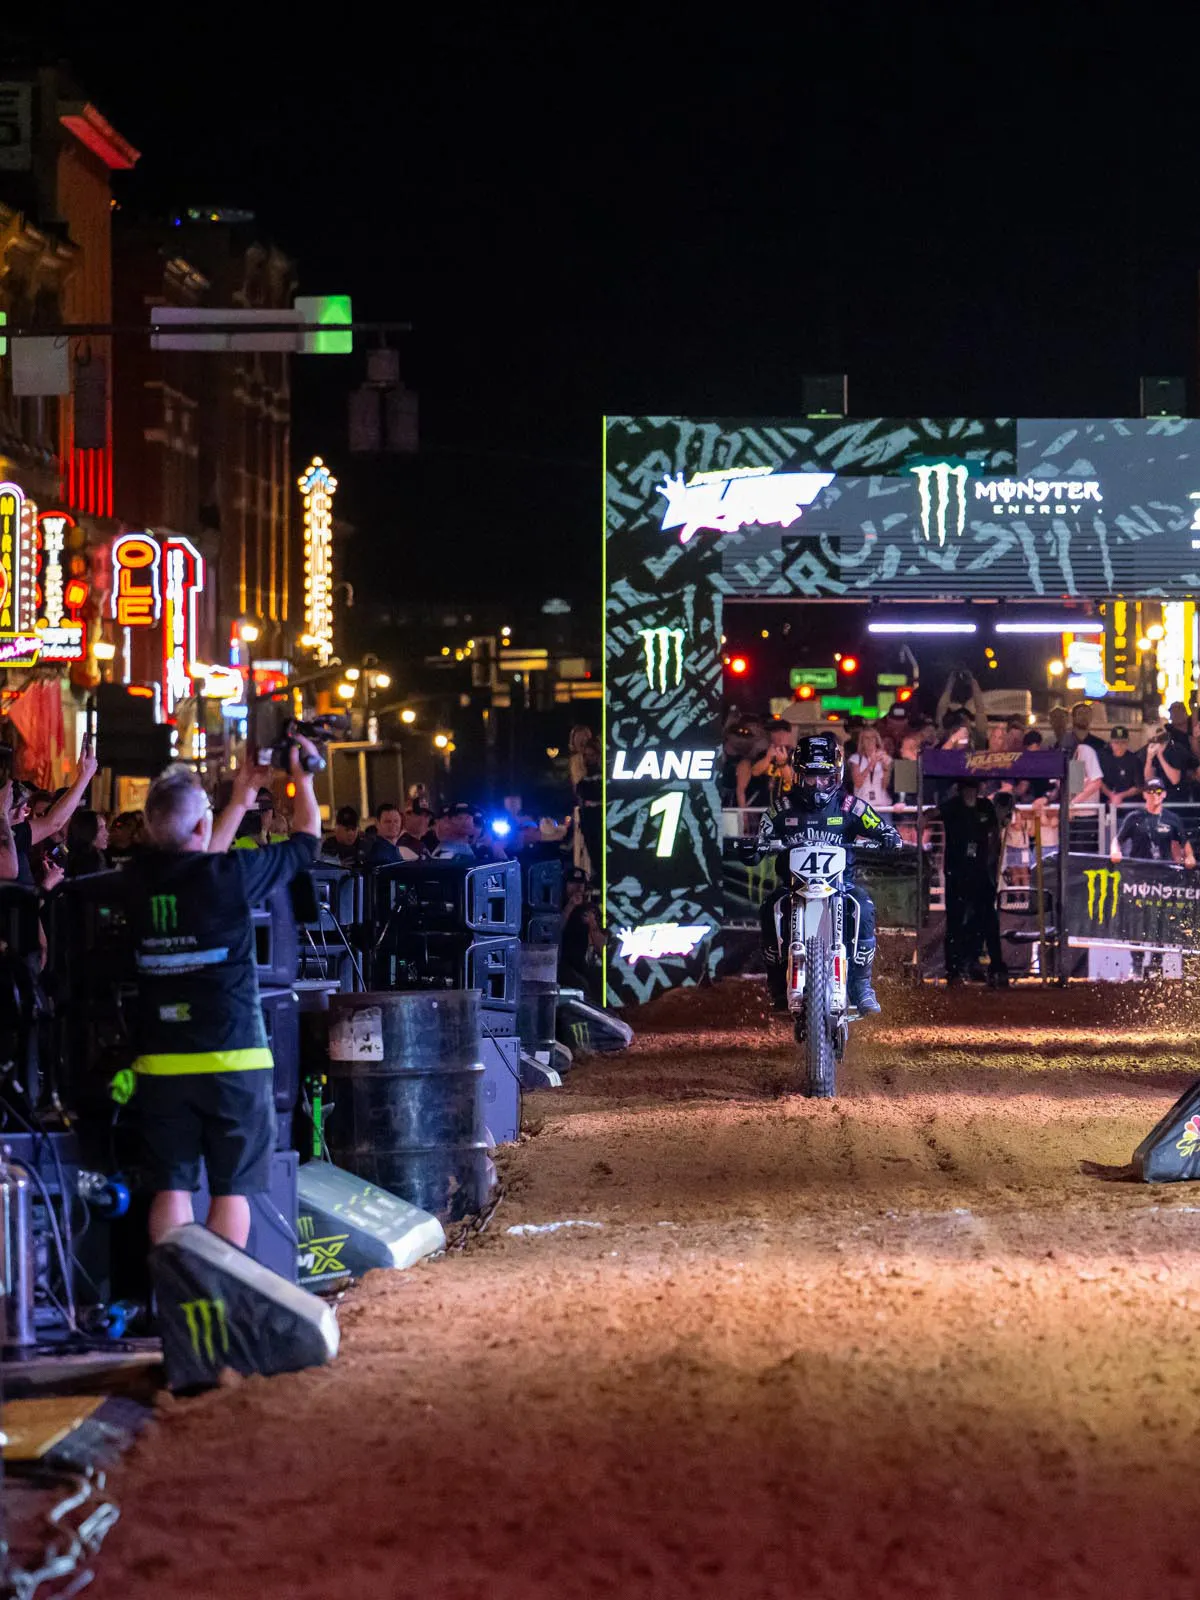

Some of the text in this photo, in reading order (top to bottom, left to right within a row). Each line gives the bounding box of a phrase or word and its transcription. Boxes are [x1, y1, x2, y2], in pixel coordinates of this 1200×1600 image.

[975, 478, 1104, 503] MONSTER
[993, 505, 1081, 514] ENERGY
[117, 540, 154, 625] OLE
[612, 751, 716, 779] LANE
[650, 791, 684, 857] 1
[799, 852, 837, 874] 47
[297, 1242, 347, 1275] MX
